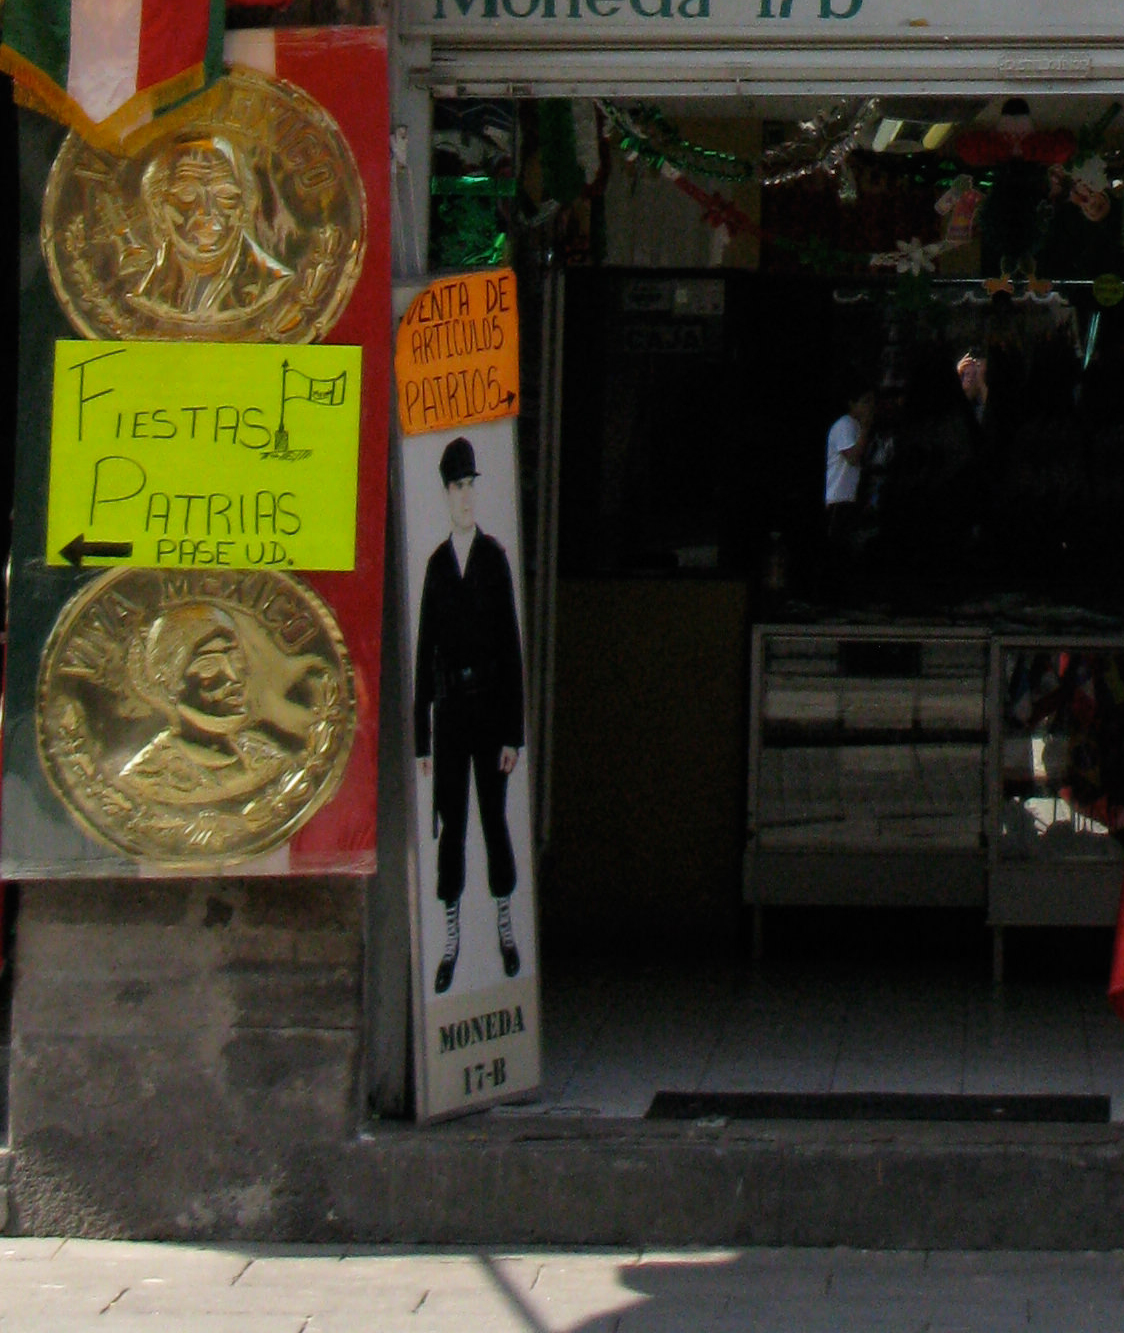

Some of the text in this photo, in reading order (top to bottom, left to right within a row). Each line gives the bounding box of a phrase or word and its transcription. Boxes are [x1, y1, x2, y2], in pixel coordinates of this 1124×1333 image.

[486, 276, 510, 314] DE
[411, 315, 504, 364] ARTICULOS
[405, 366, 501, 425] PATRIOS
[89, 455, 301, 537] PATRIAS
[156, 539, 295, 566] PASE UD.
[439, 1005, 526, 1054] MONEDA
[464, 1057, 506, 1096] 17-B
